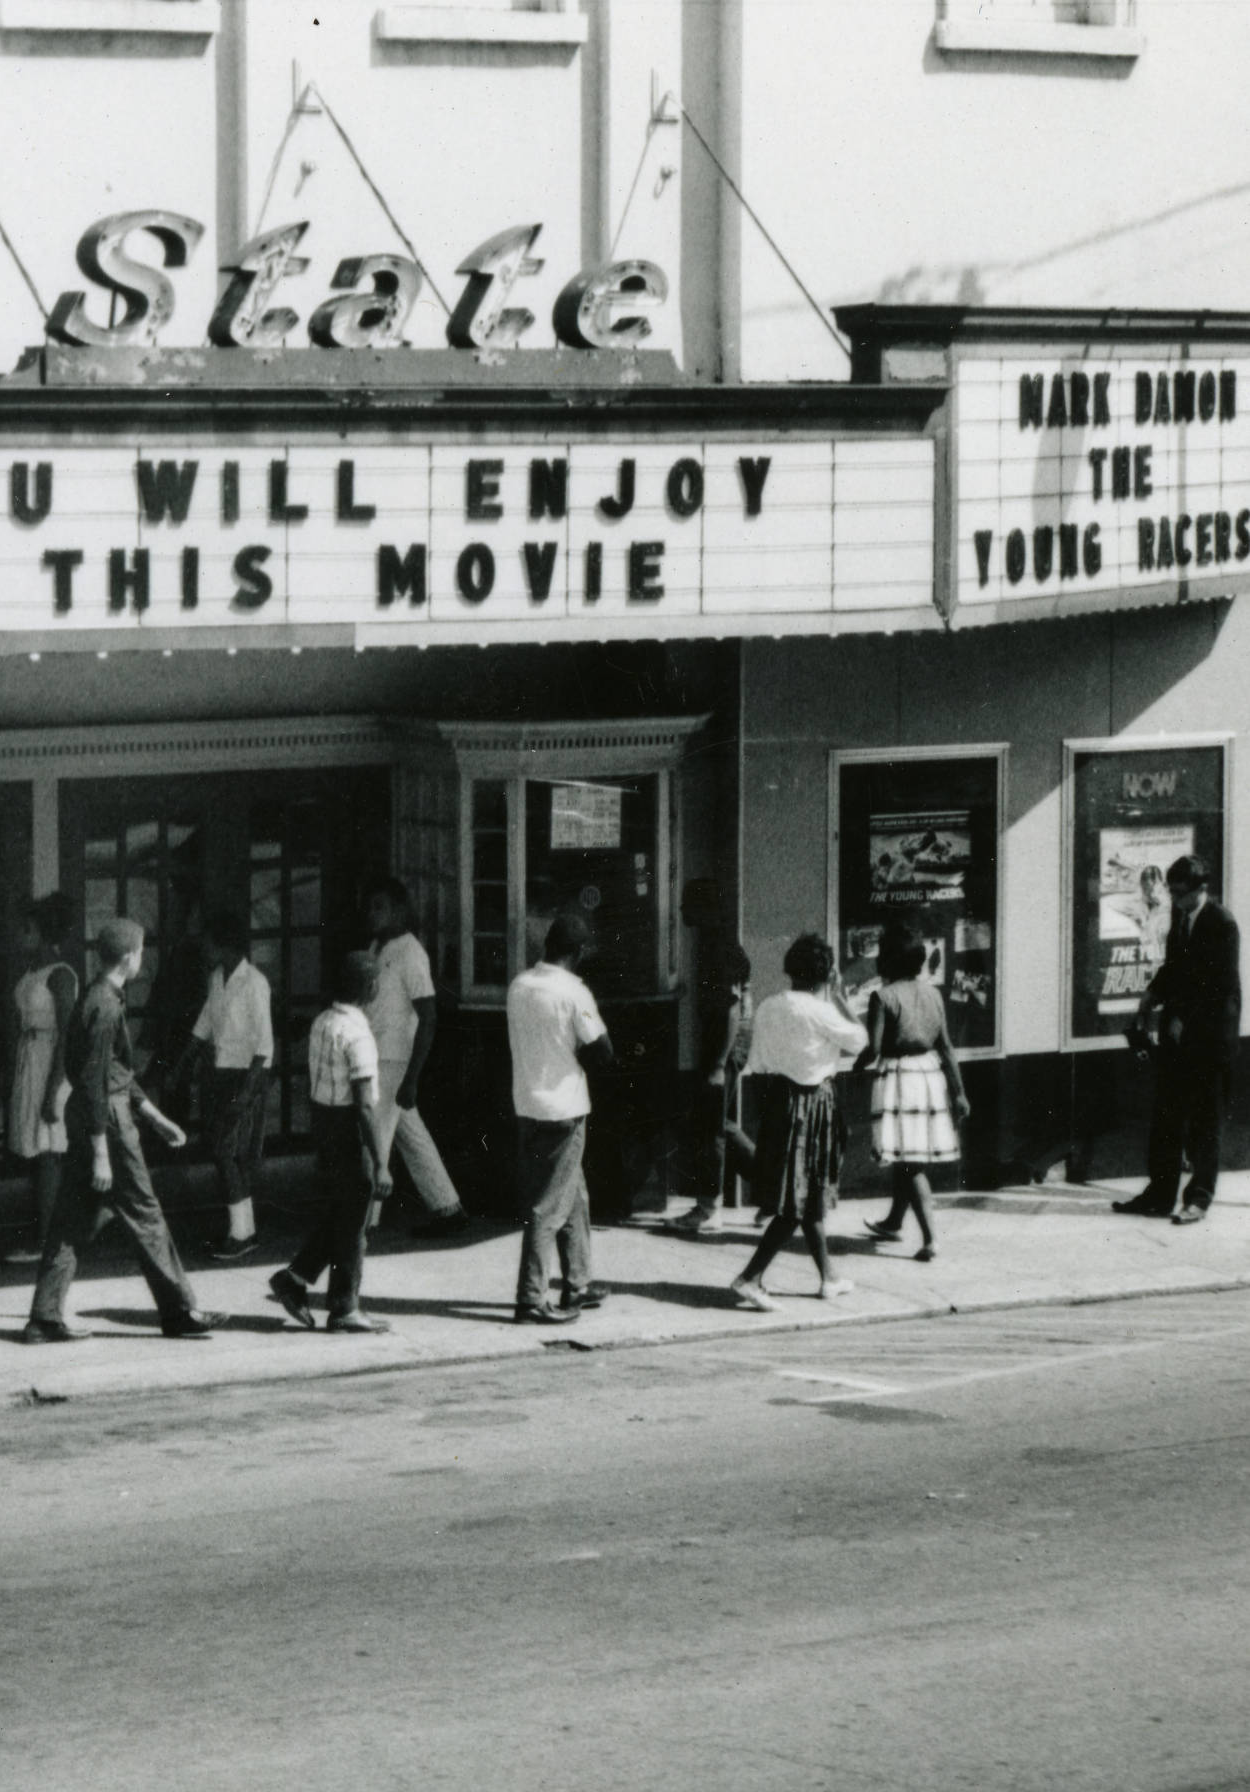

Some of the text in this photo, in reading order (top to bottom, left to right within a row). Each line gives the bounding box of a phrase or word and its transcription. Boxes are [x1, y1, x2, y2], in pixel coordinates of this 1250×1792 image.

[45, 209, 669, 349] State
[1019, 369, 1237, 431] MARK DAMON
[136, 458, 376, 528] WILL
[465, 455, 773, 523] ENJOY
[1089, 445, 1152, 504] THE
[40, 540, 667, 616] THIS MOVIE
[974, 508, 1250, 588] YOUNG RACERS
[1123, 770, 1176, 799] NOW
[889, 890, 923, 902] YOUNG
[1111, 946, 1137, 963] THE
